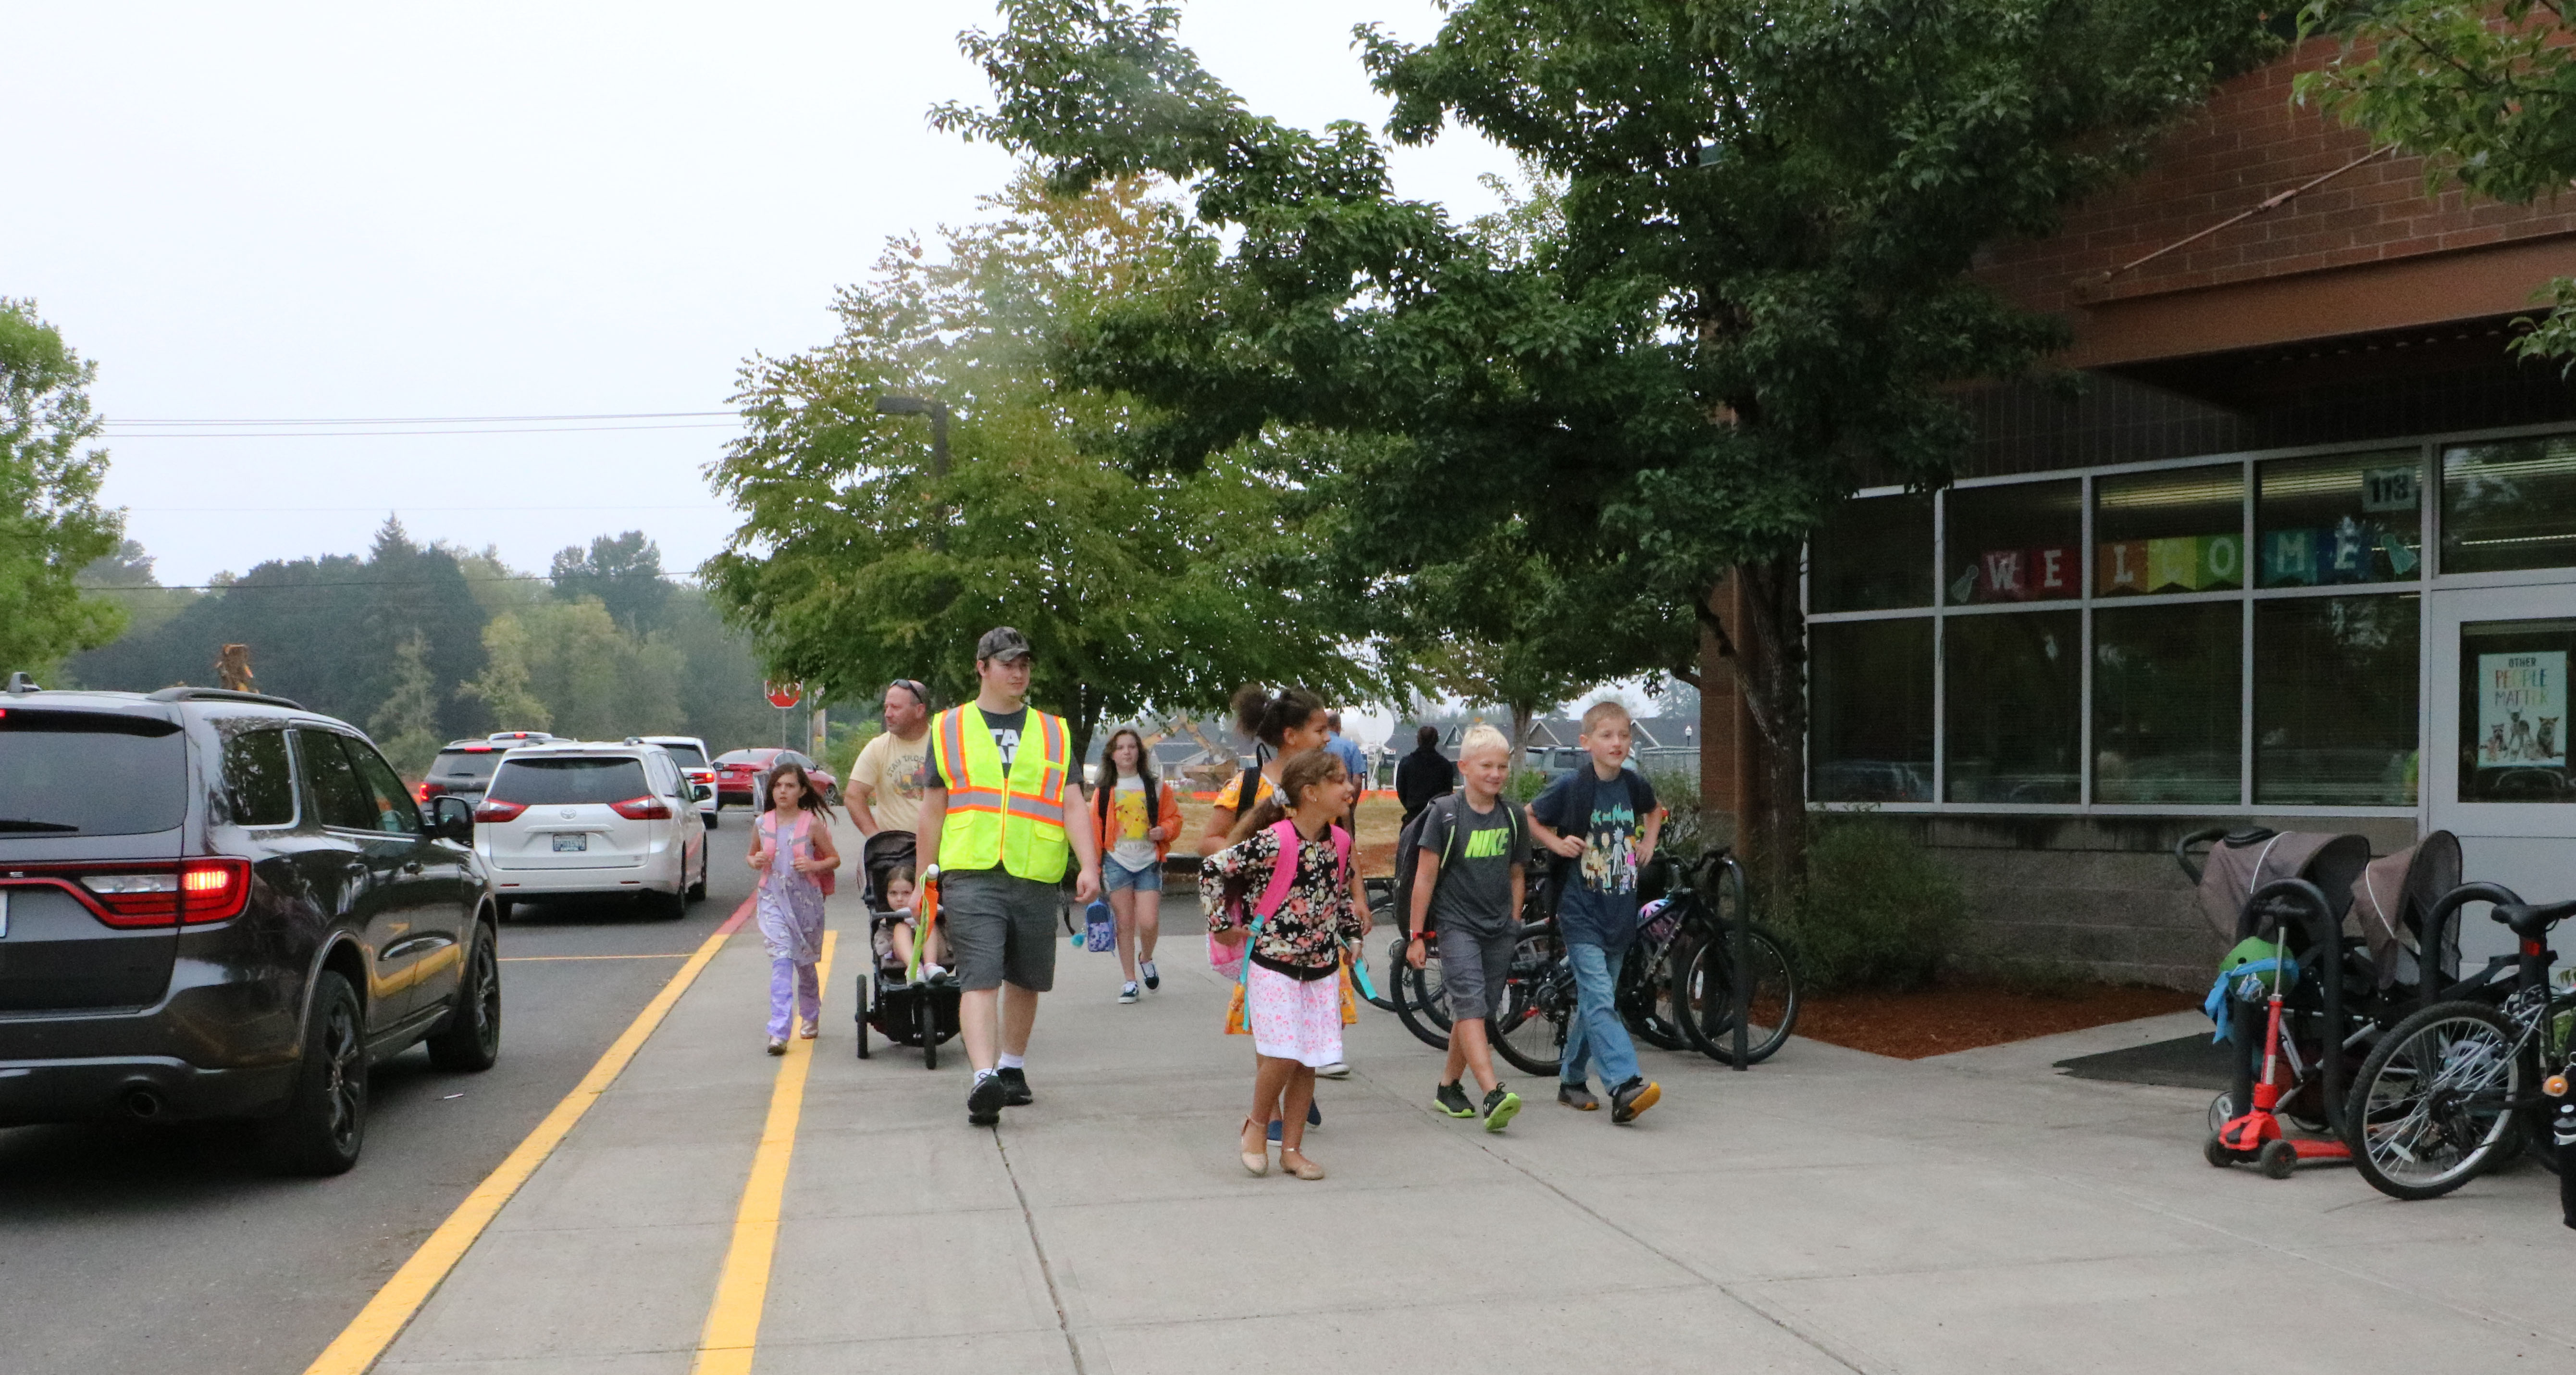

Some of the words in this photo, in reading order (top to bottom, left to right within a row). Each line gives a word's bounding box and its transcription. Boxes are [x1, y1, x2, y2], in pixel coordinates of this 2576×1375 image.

[1987, 529, 2361, 591] WELCOME
[2508, 657, 2536, 668] OTHER
[2495, 668, 2547, 688] PEOPLE
[1464, 827, 1510, 858] NIKE
